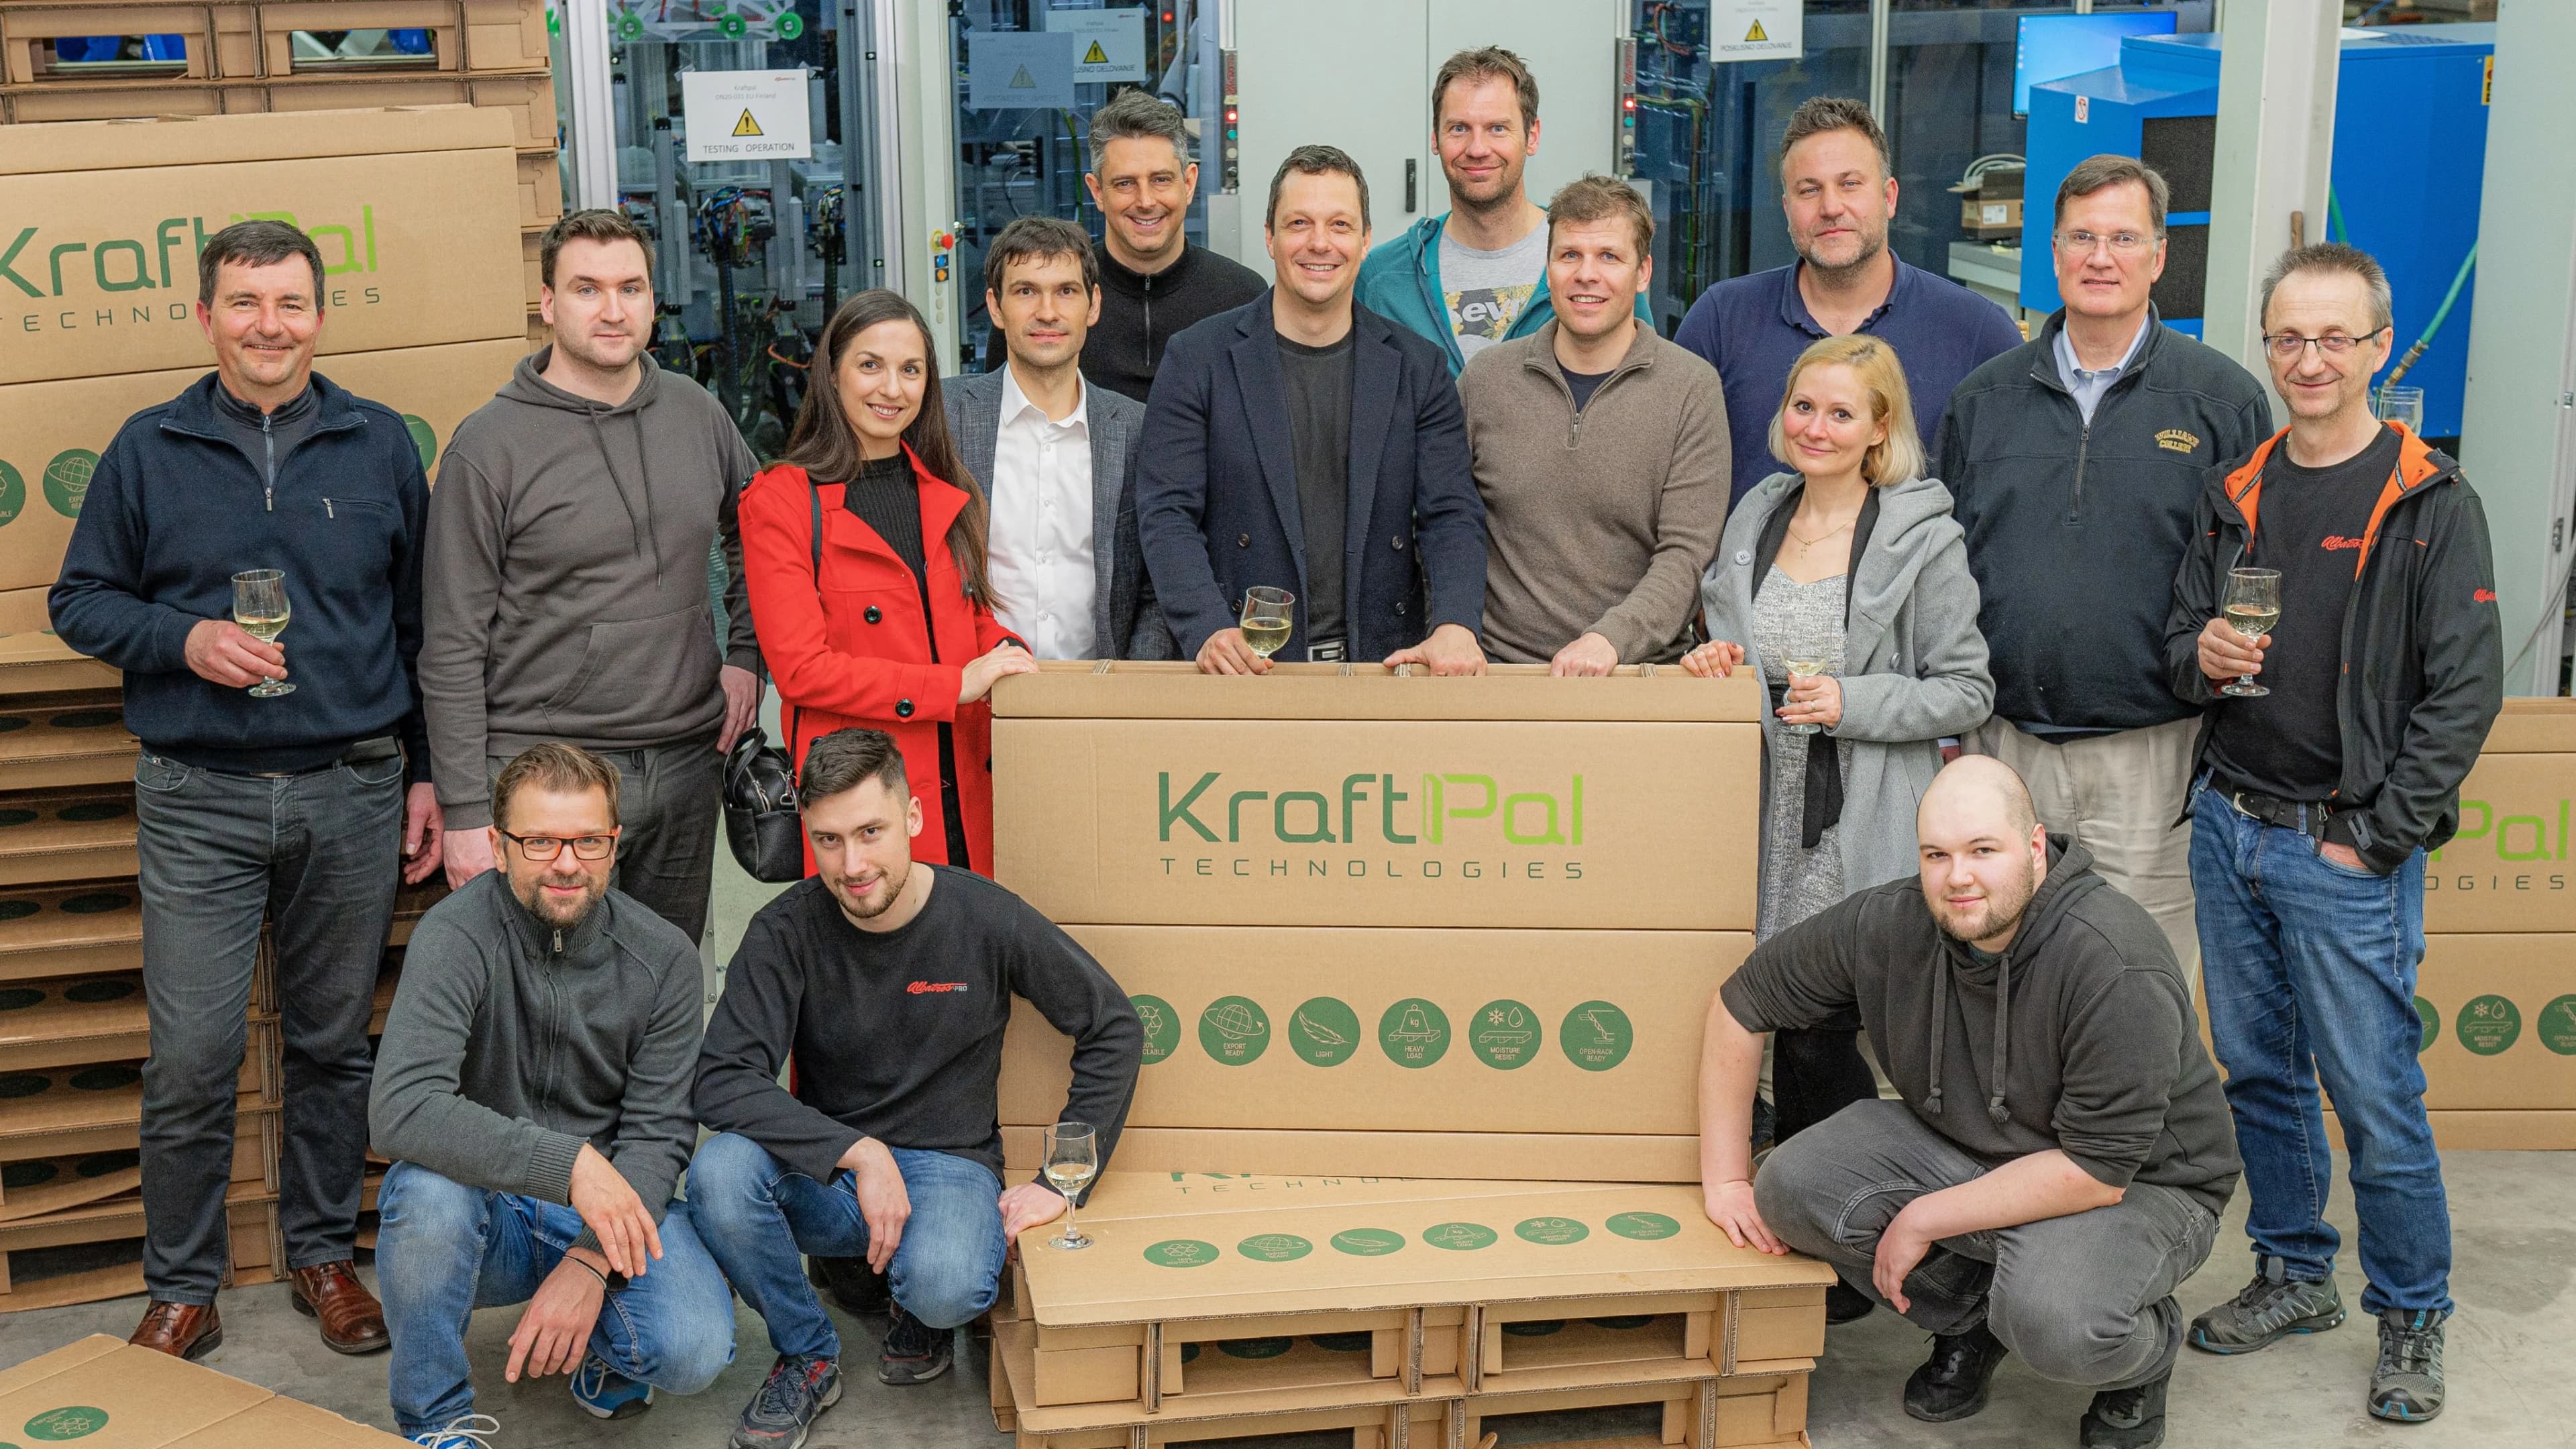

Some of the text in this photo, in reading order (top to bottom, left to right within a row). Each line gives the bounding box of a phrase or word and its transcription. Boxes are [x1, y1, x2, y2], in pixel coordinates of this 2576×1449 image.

[703, 143, 795, 154] TESTING OPERATION
[1159, 771, 1583, 845] KraftPal
[1160, 858, 1582, 879] TECHNOLOGIES
[1410, 1018, 1419, 1027] kg
